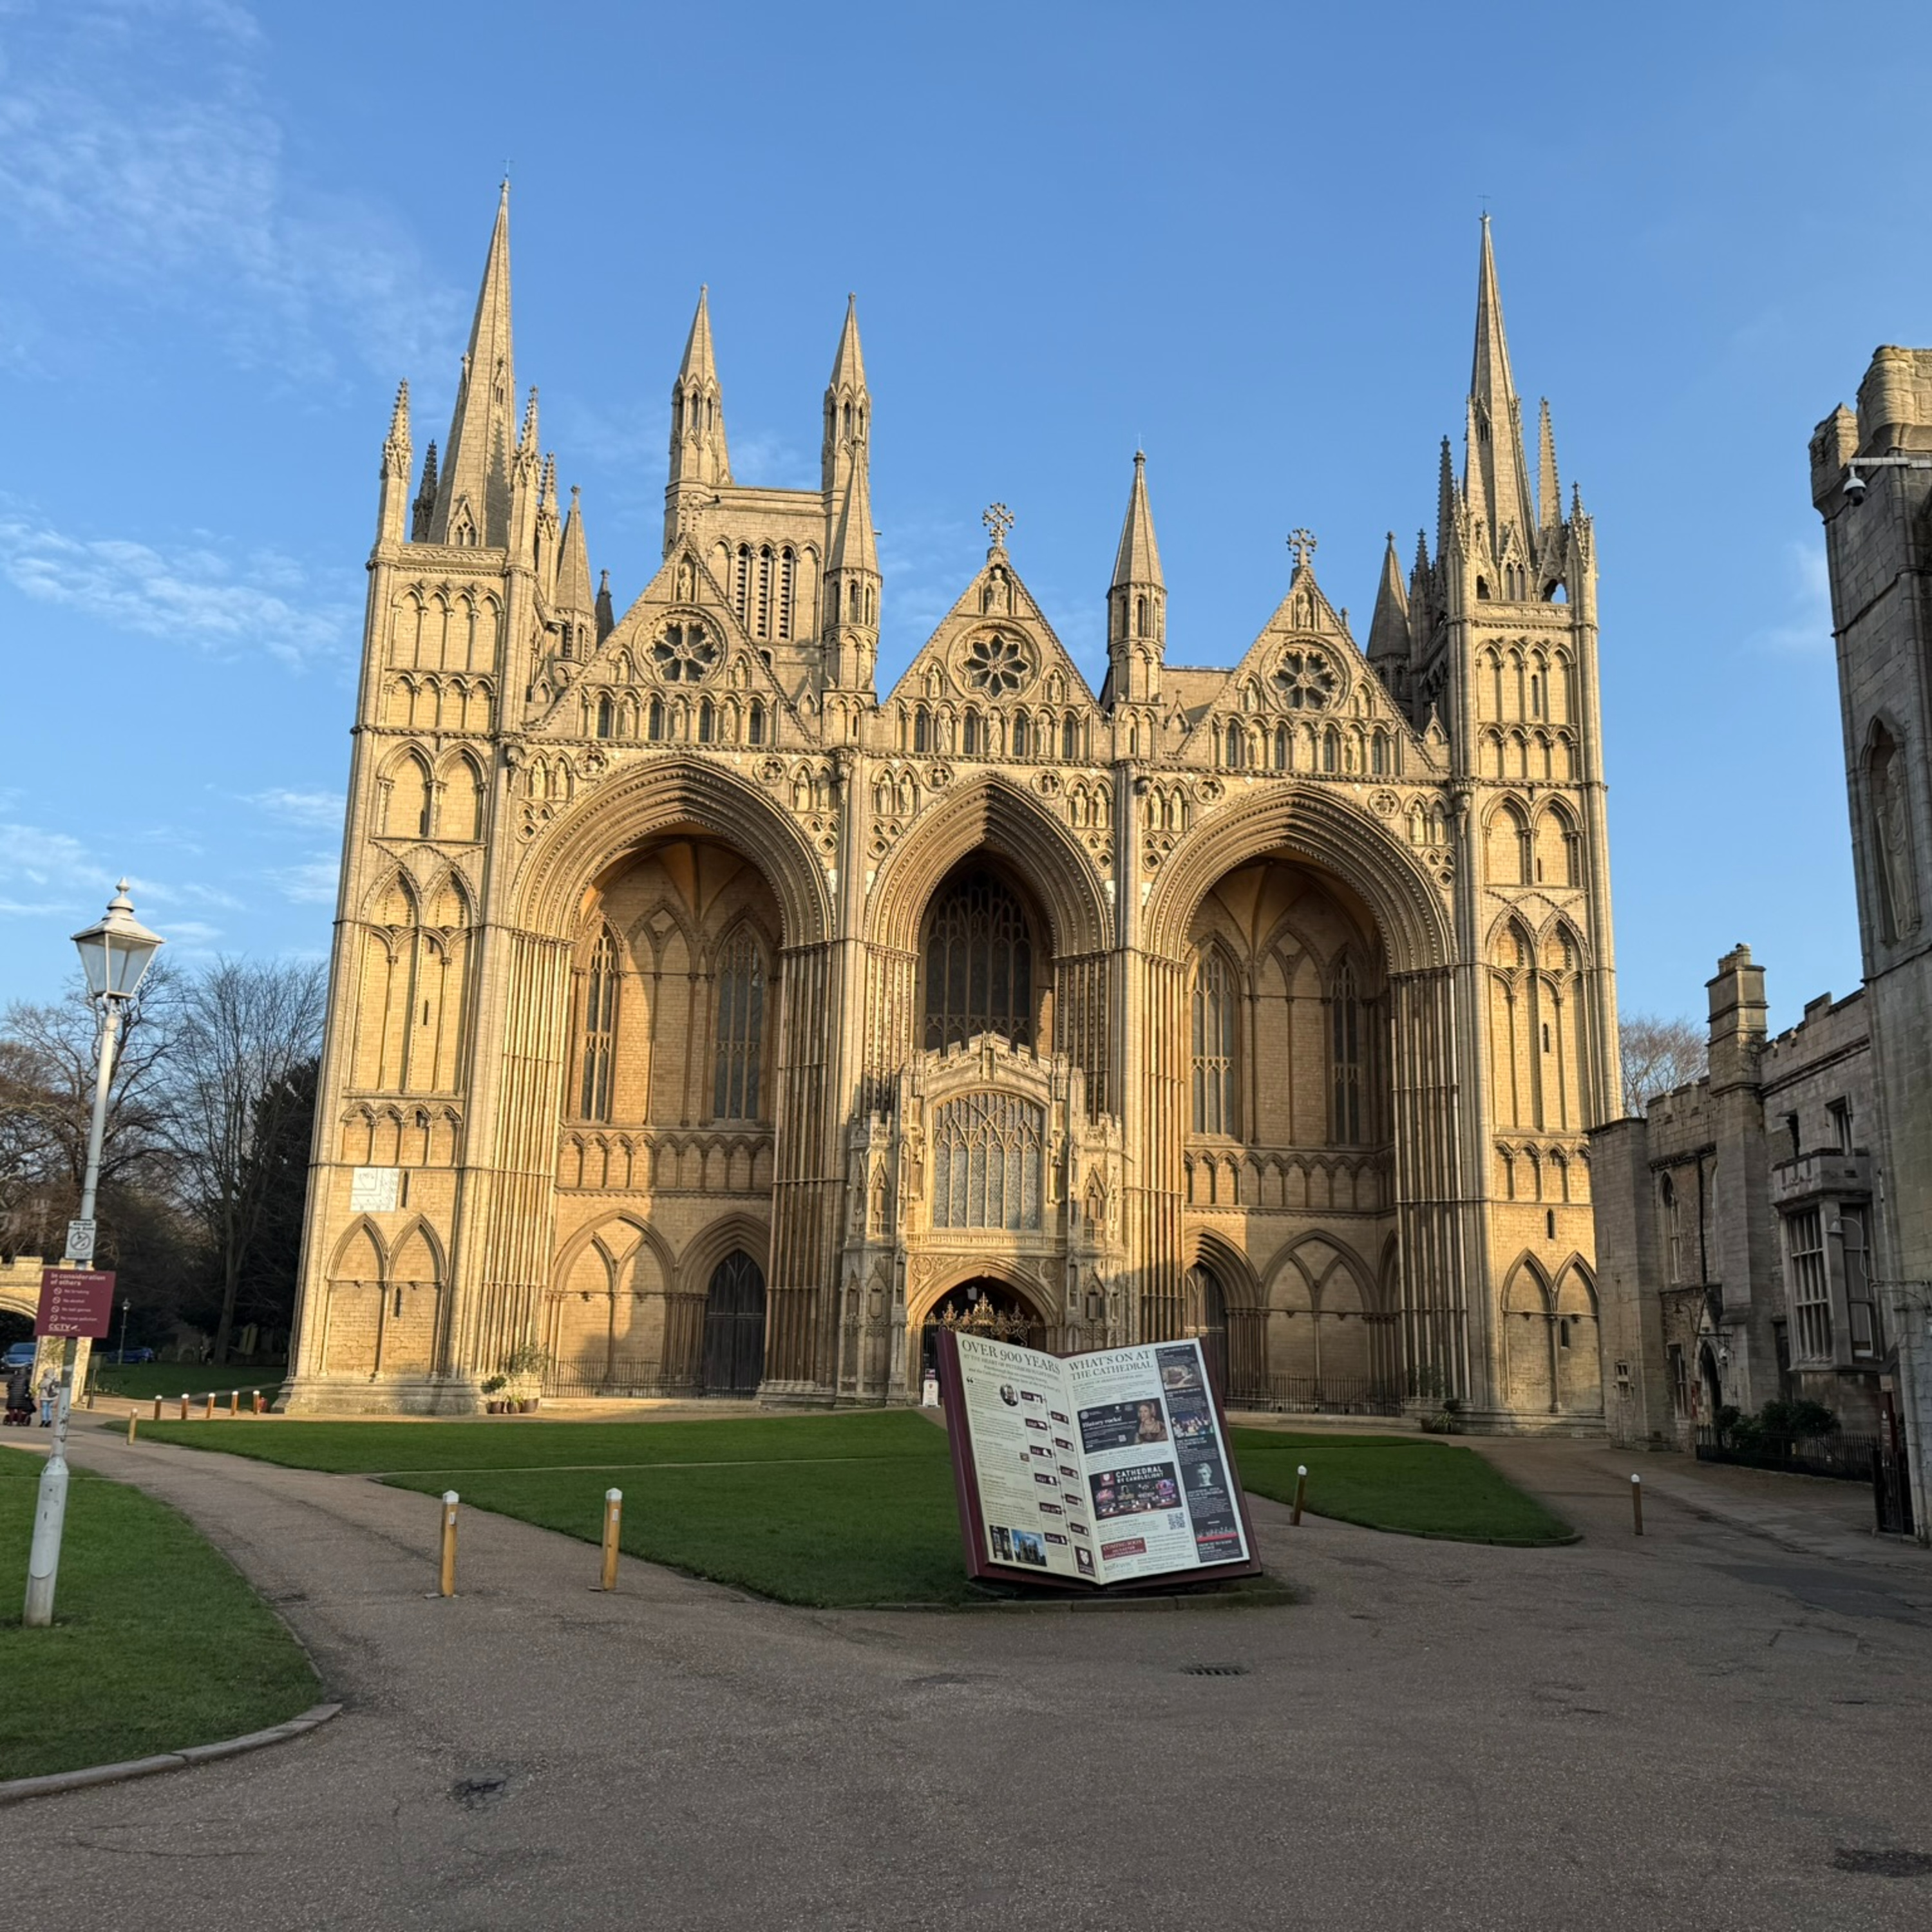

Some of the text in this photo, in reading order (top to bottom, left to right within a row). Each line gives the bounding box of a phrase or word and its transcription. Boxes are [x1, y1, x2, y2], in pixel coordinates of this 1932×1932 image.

[962, 1340, 1061, 1375] OVER 900 YEARS
[1068, 1354, 1113, 1371] WHAT'S
[1115, 1352, 1133, 1363] ON
[1136, 1350, 1151, 1360] AT
[1070, 1369, 1092, 1381] THE
[1093, 1361, 1153, 1376] CATHEDRAL
[1115, 1466, 1163, 1478] CATHEDRAL
